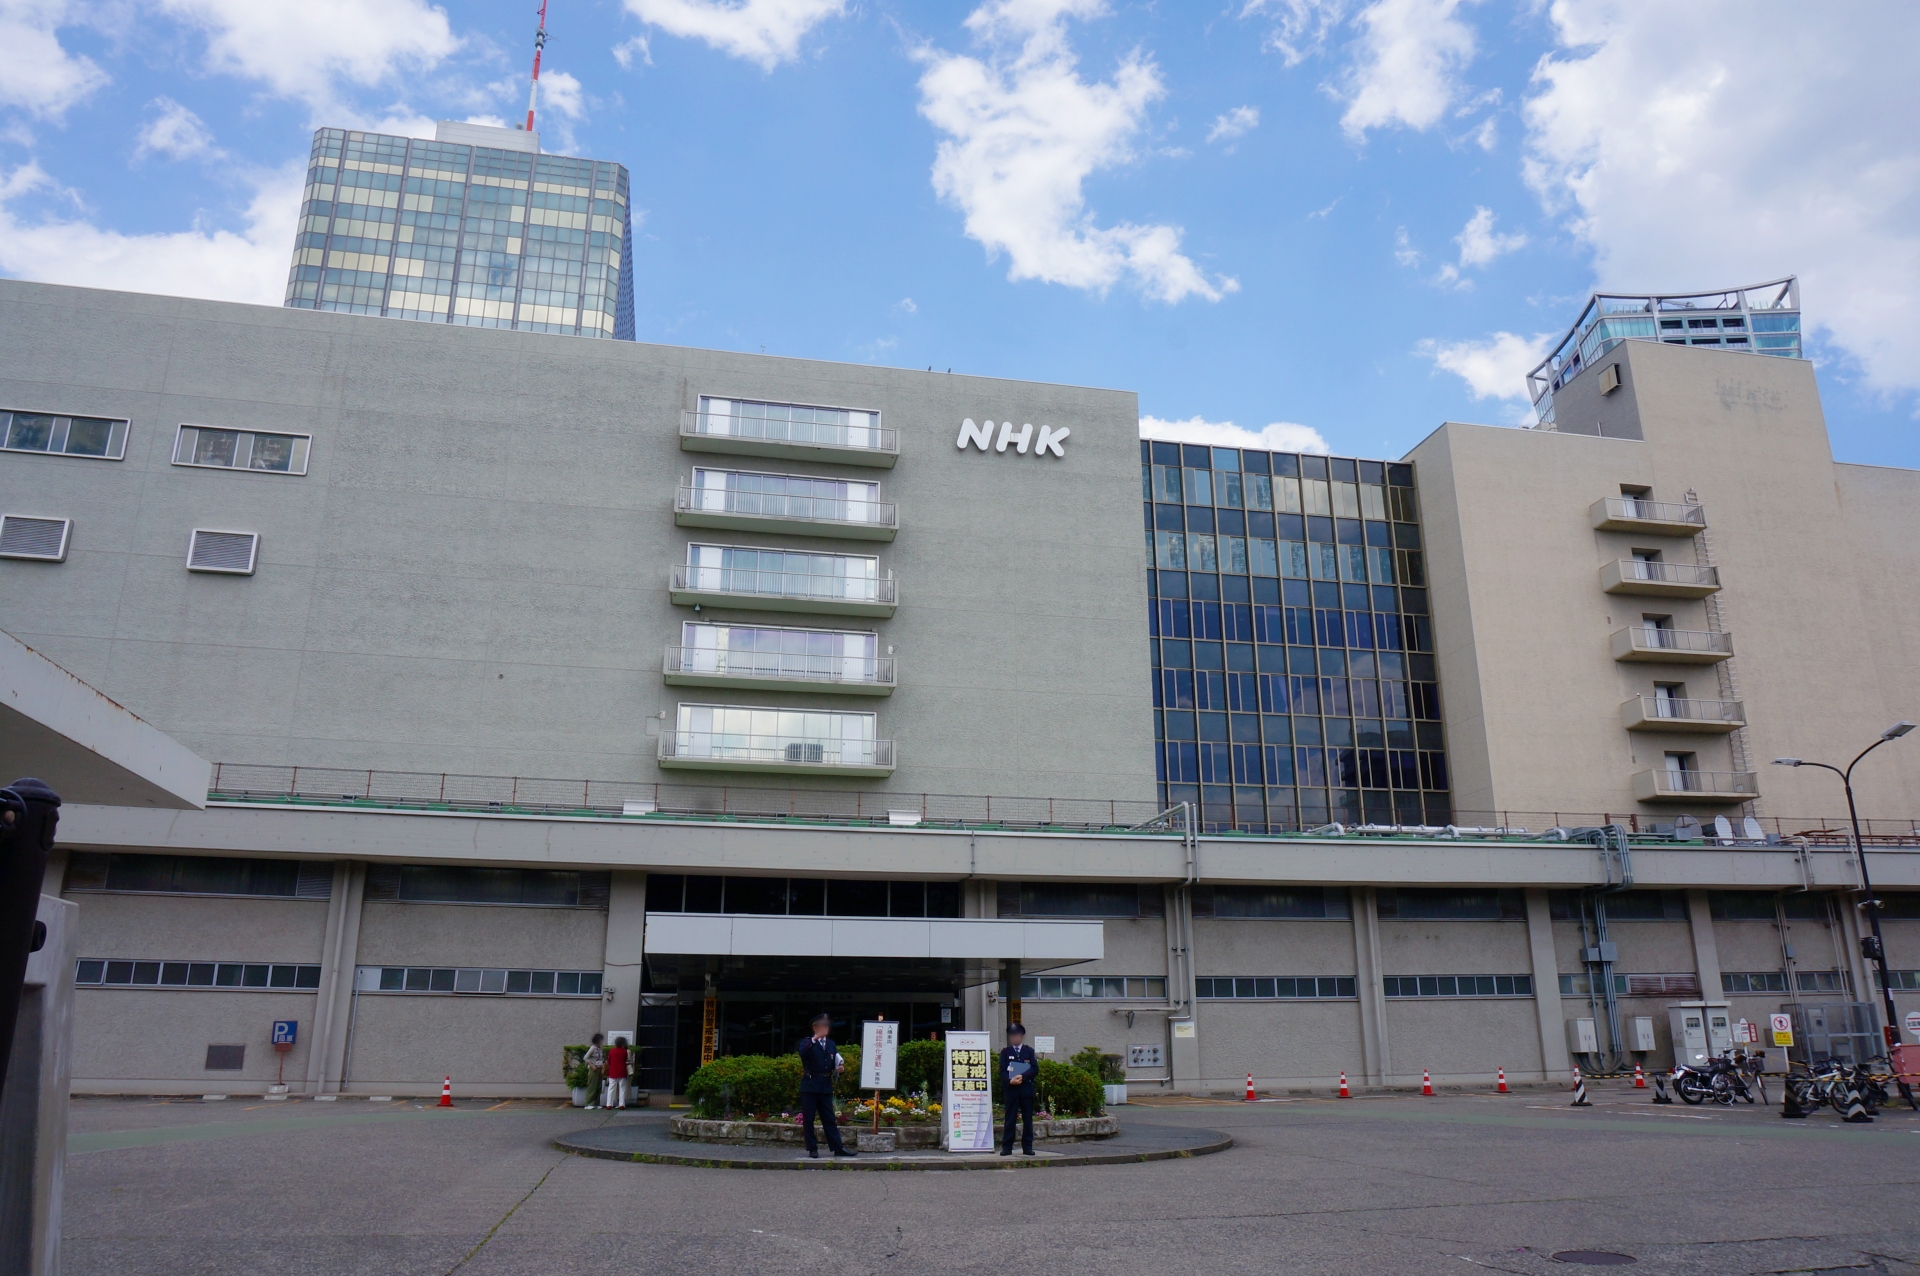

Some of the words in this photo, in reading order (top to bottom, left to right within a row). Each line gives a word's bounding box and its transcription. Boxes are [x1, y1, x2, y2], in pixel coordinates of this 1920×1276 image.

[957, 418, 1070, 457] NHK
[273, 1022, 289, 1043] P
[704, 1000, 715, 1063] 特別警戒実施中
[952, 1050, 986, 1065] 特別
[952, 1064, 987, 1079] 警戒
[953, 1080, 987, 1091] 実施中
